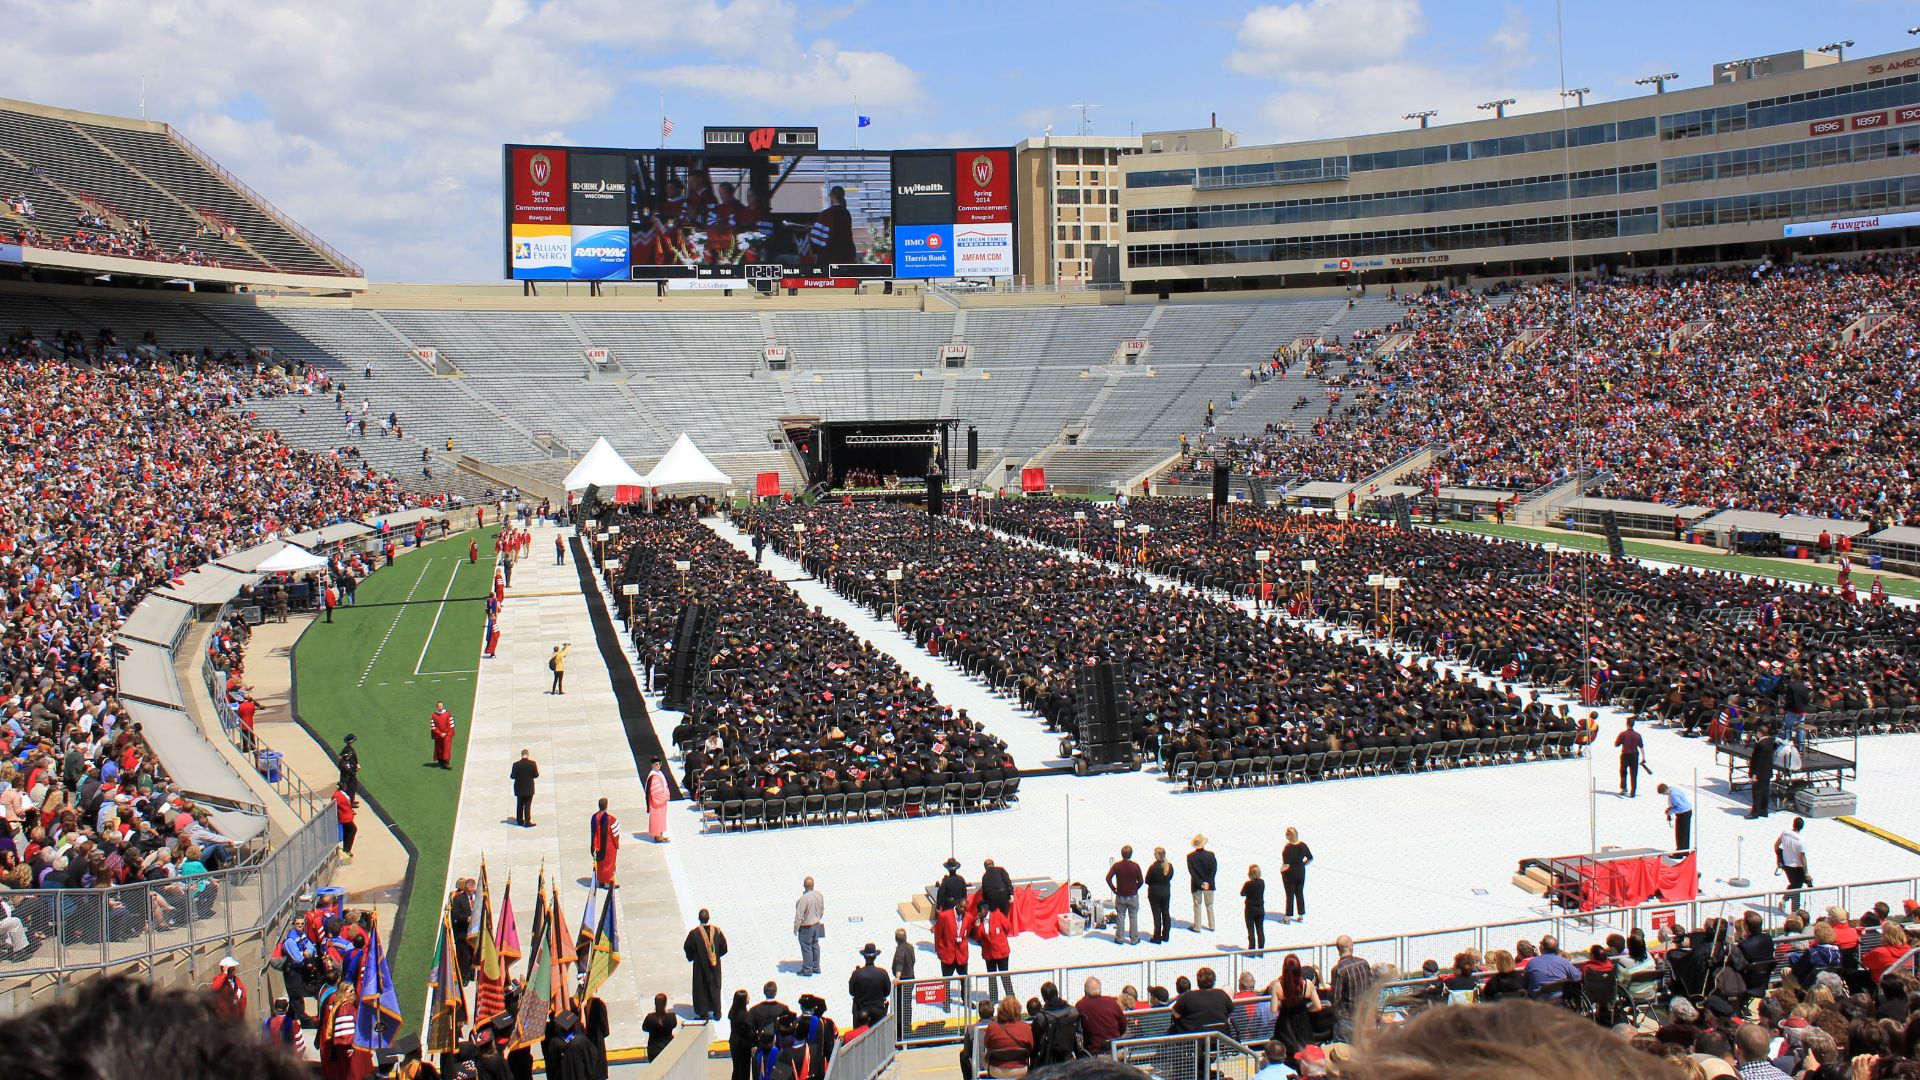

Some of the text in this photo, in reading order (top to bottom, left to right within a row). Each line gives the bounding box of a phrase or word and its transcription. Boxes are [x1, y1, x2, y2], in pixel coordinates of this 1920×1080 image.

[1868, 64, 1883, 74] 35
[1856, 115, 1880, 126] 1897
[1814, 122, 1839, 132] 1896
[749, 128, 776, 152] W
[534, 164, 546, 180] W
[977, 165, 988, 181] W
[1830, 217, 1879, 230] #uwgrad
[534, 243, 567, 252] ALLIANT
[574, 247, 627, 257] RAYOVAC
[534, 252, 567, 260] ENERGY
[961, 253, 1002, 261] AMFAM.COM
[1391, 256, 1426, 265] VARSITY
[752, 266, 780, 277] 12:02
